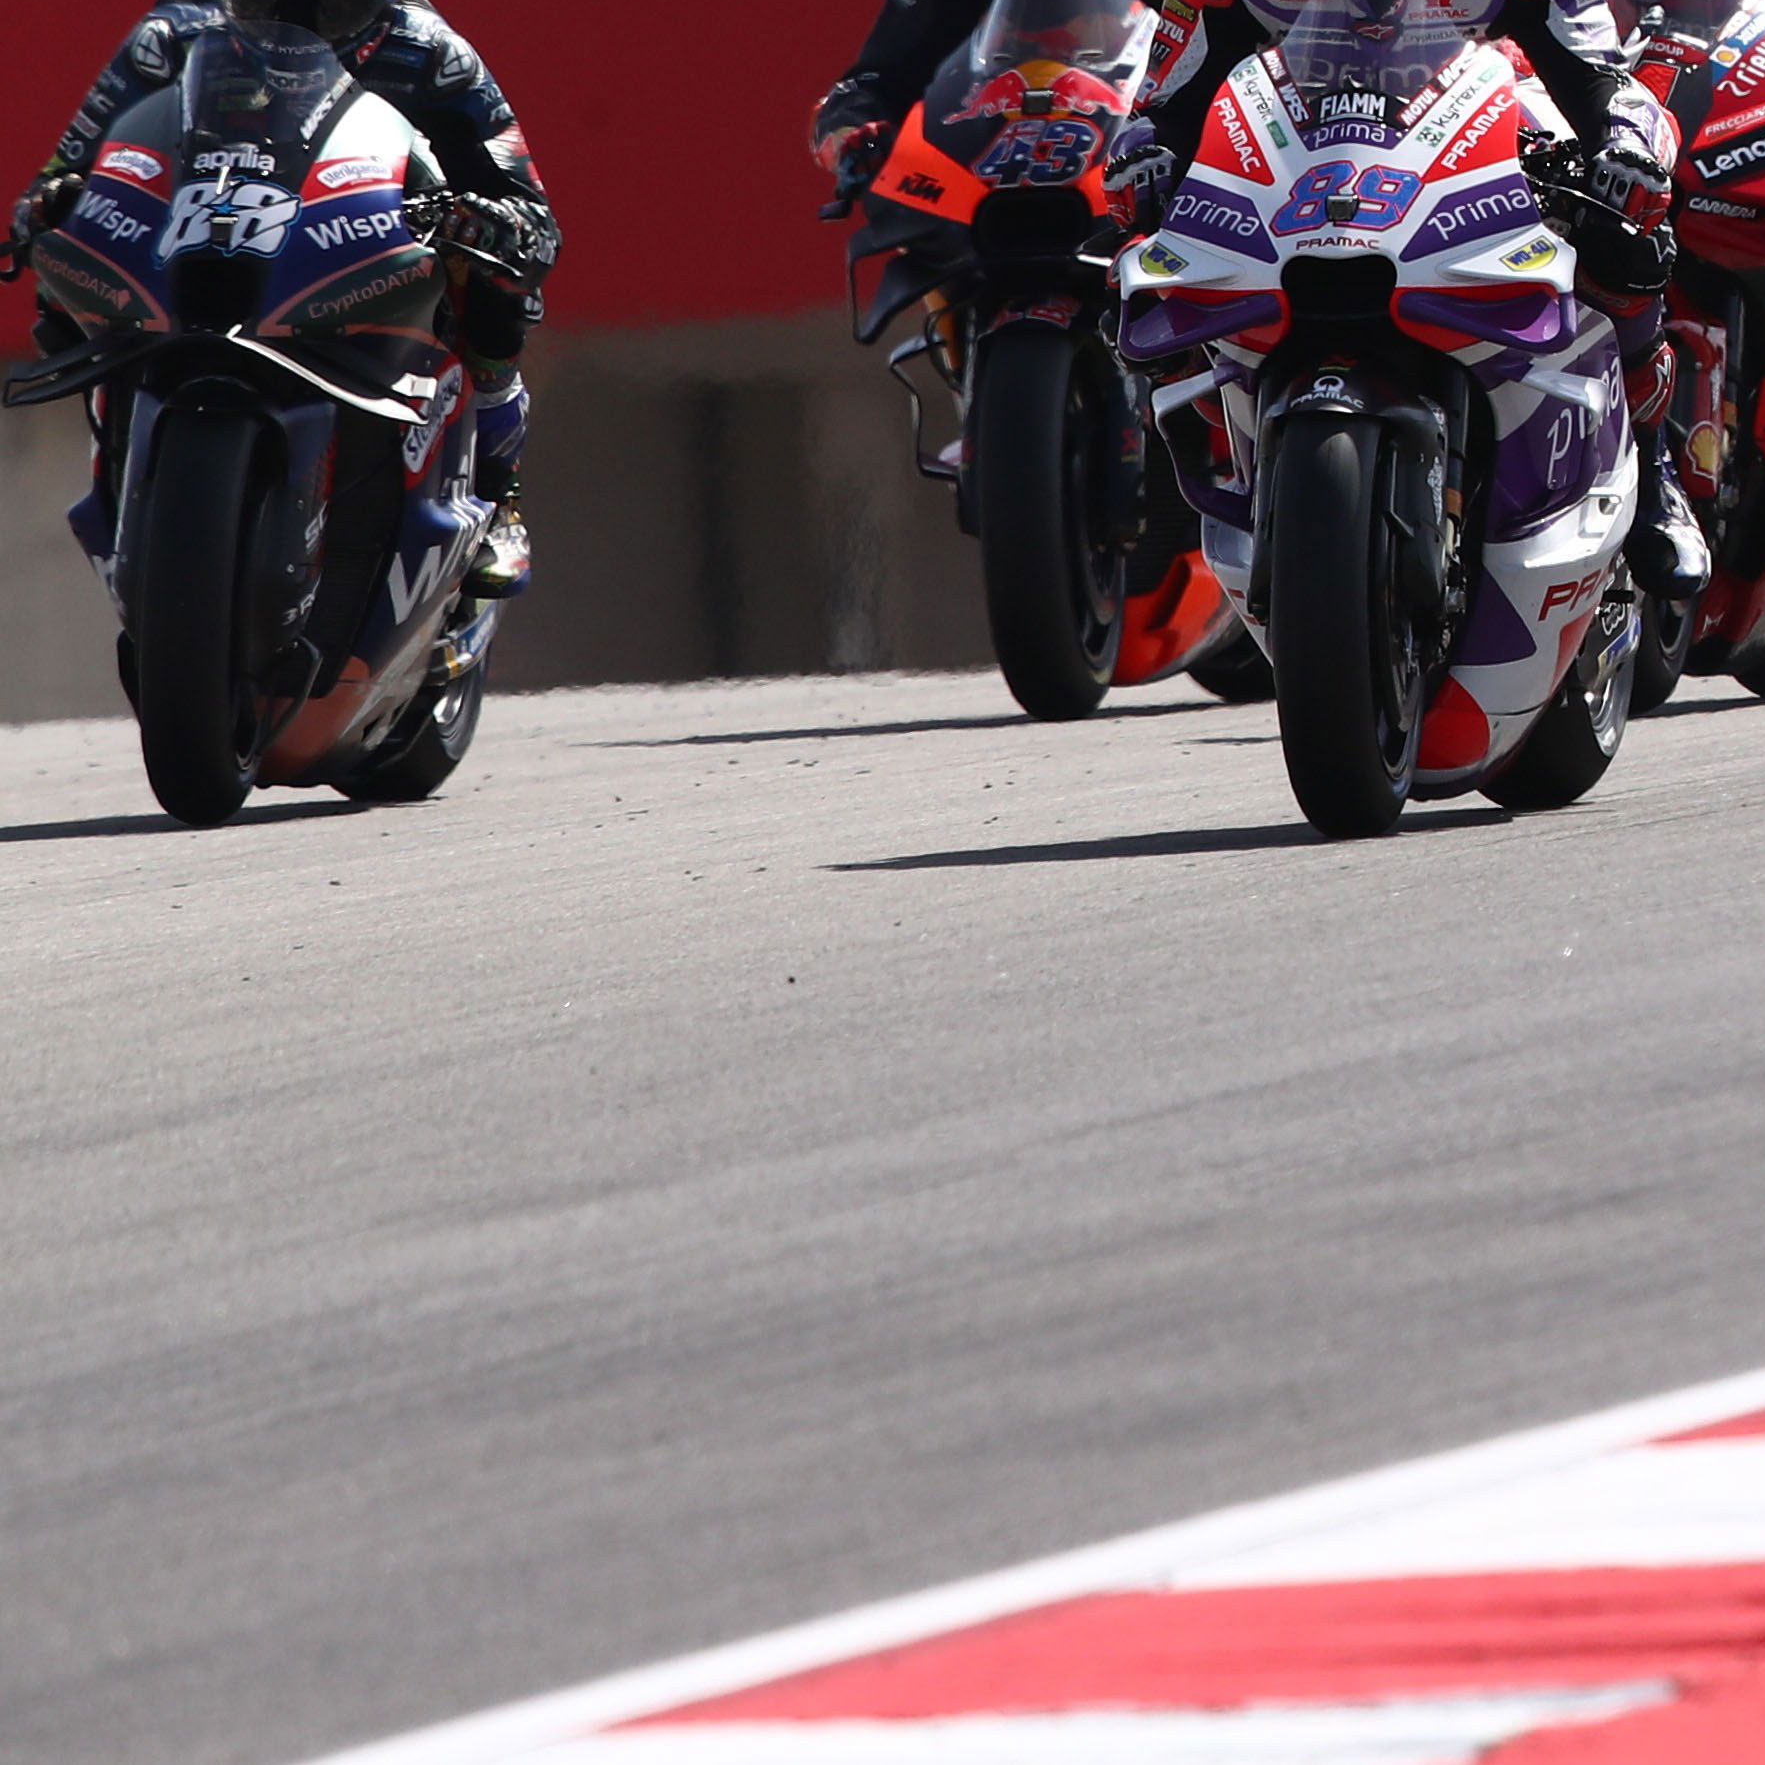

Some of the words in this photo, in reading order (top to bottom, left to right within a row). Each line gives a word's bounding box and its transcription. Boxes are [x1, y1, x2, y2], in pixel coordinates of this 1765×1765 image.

[1649, 38, 1685, 57] ROUP
[1319, 92, 1387, 119] FIAMM
[1401, 86, 1440, 127] MOTUL
[1213, 96, 1262, 173] PRAMAC
[1312, 126, 1386, 148] prima
[1440, 93, 1517, 171] PRAMAC
[192, 150, 276, 173] aprilia
[973, 119, 1100, 190] 43
[896, 171, 947, 204] KTM
[1268, 159, 1427, 233] 89
[1688, 196, 1757, 219] CARRERA
[76, 190, 152, 242] Wispr
[304, 208, 402, 251] Wispr
[1168, 194, 1260, 237] prima
[1427, 188, 1531, 241] prima
[1295, 236, 1381, 251] PRAMAC
[1506, 239, 1550, 268] WD-40
[307, 260, 424, 320] CryptoDATA
